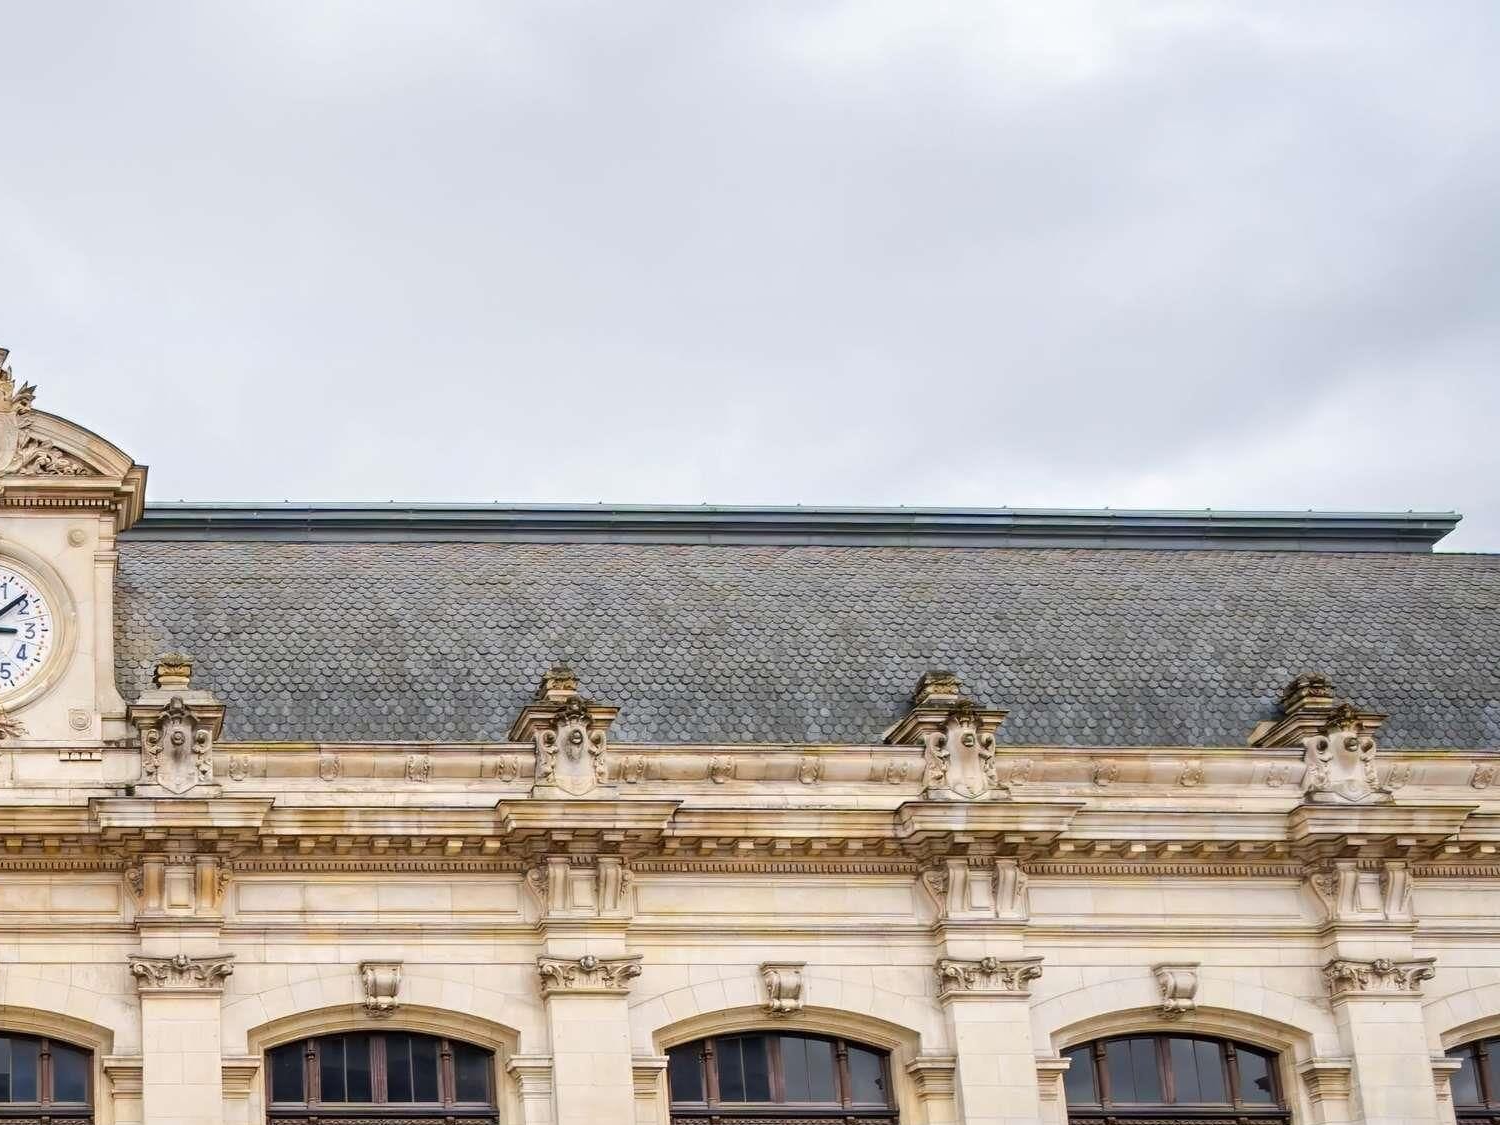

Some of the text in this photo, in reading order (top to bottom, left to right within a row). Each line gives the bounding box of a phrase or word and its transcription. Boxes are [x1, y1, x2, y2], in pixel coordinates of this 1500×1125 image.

[0, 582, 8, 599] 1
[17, 597, 30, 616] 2
[25, 622, 36, 640] 3
[16, 643, 28, 661] 4
[0, 662, 11, 680] 5
